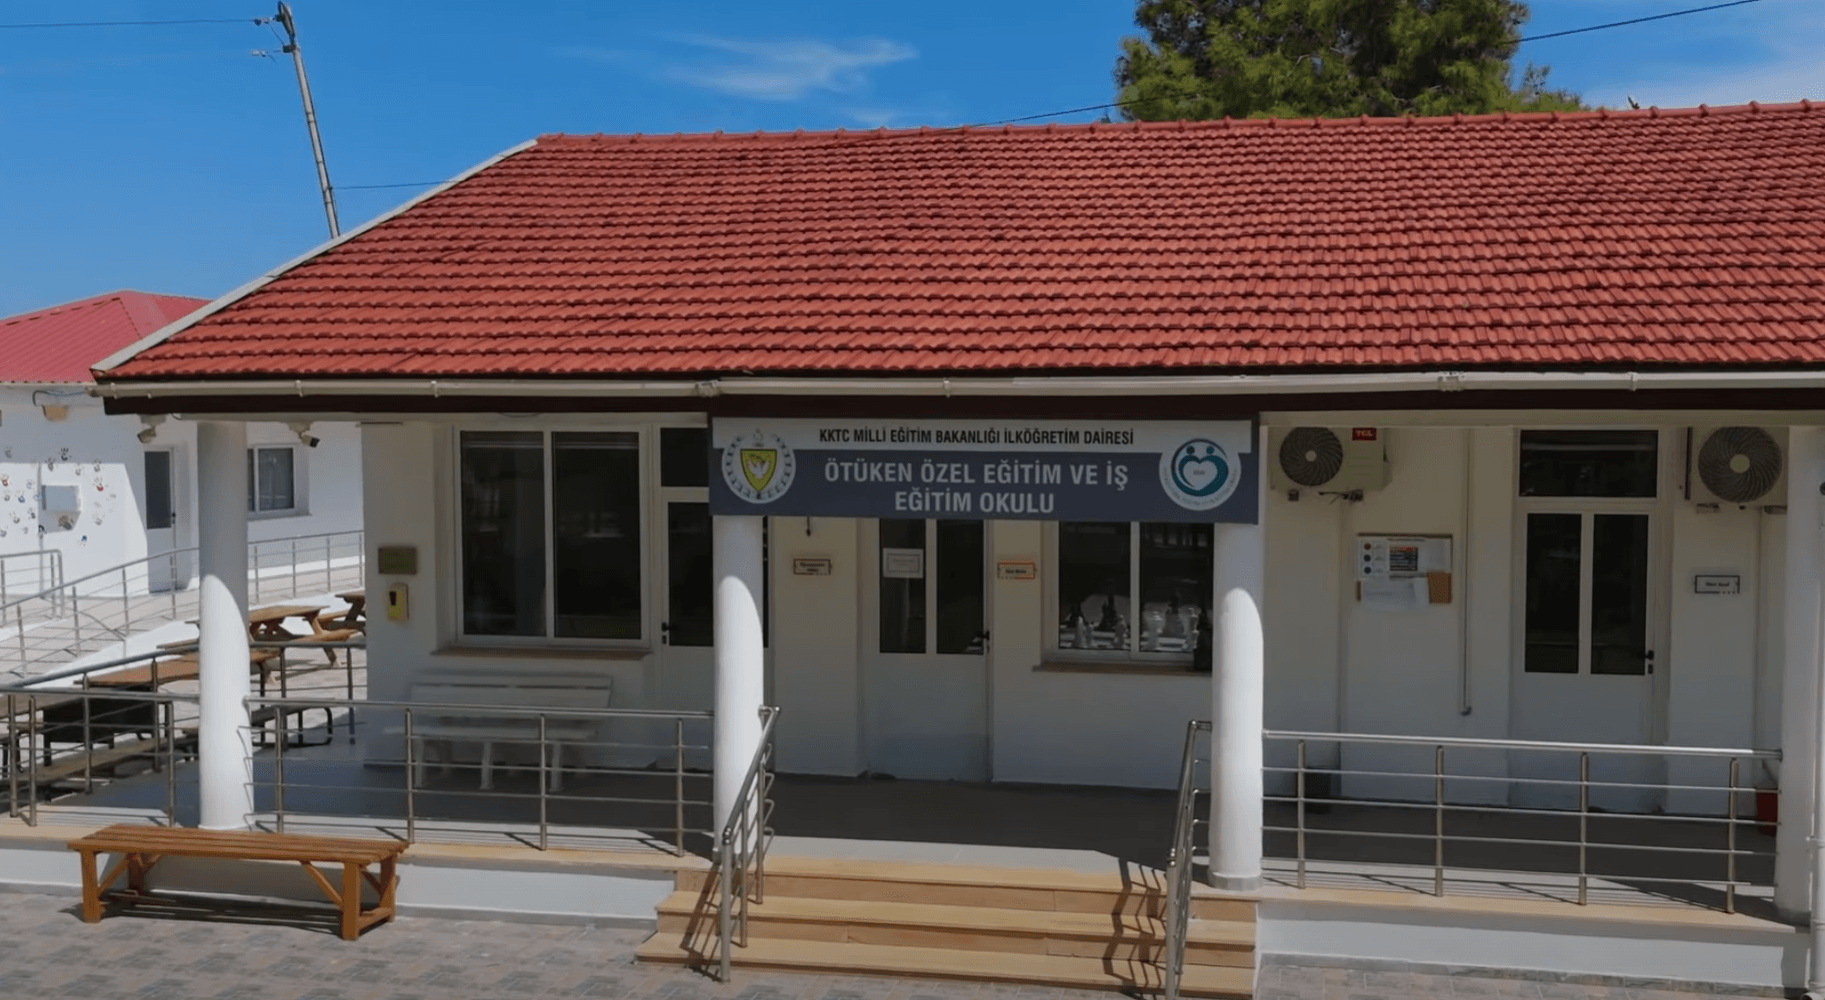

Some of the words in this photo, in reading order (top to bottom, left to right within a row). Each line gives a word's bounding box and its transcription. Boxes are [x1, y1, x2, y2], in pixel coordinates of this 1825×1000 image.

[819, 428, 850, 442] KKTC
[853, 426, 886, 443] MİLLİ
[890, 426, 932, 443] EĞİTİM
[935, 427, 1000, 444] BAKANLIĞI
[1004, 428, 1080, 445] İLKÖĞRETİM
[1083, 428, 1134, 445] DAİRESİ
[824, 458, 913, 482] ÖTÜKEN
[920, 458, 976, 483] ÖZEL
[983, 460, 1062, 484] EĞİTİM
[1069, 464, 1098, 485] VE
[1106, 461, 1128, 491] İŞ
[894, 486, 972, 512] EĞİTİM
[979, 492, 1055, 513] OKULU
